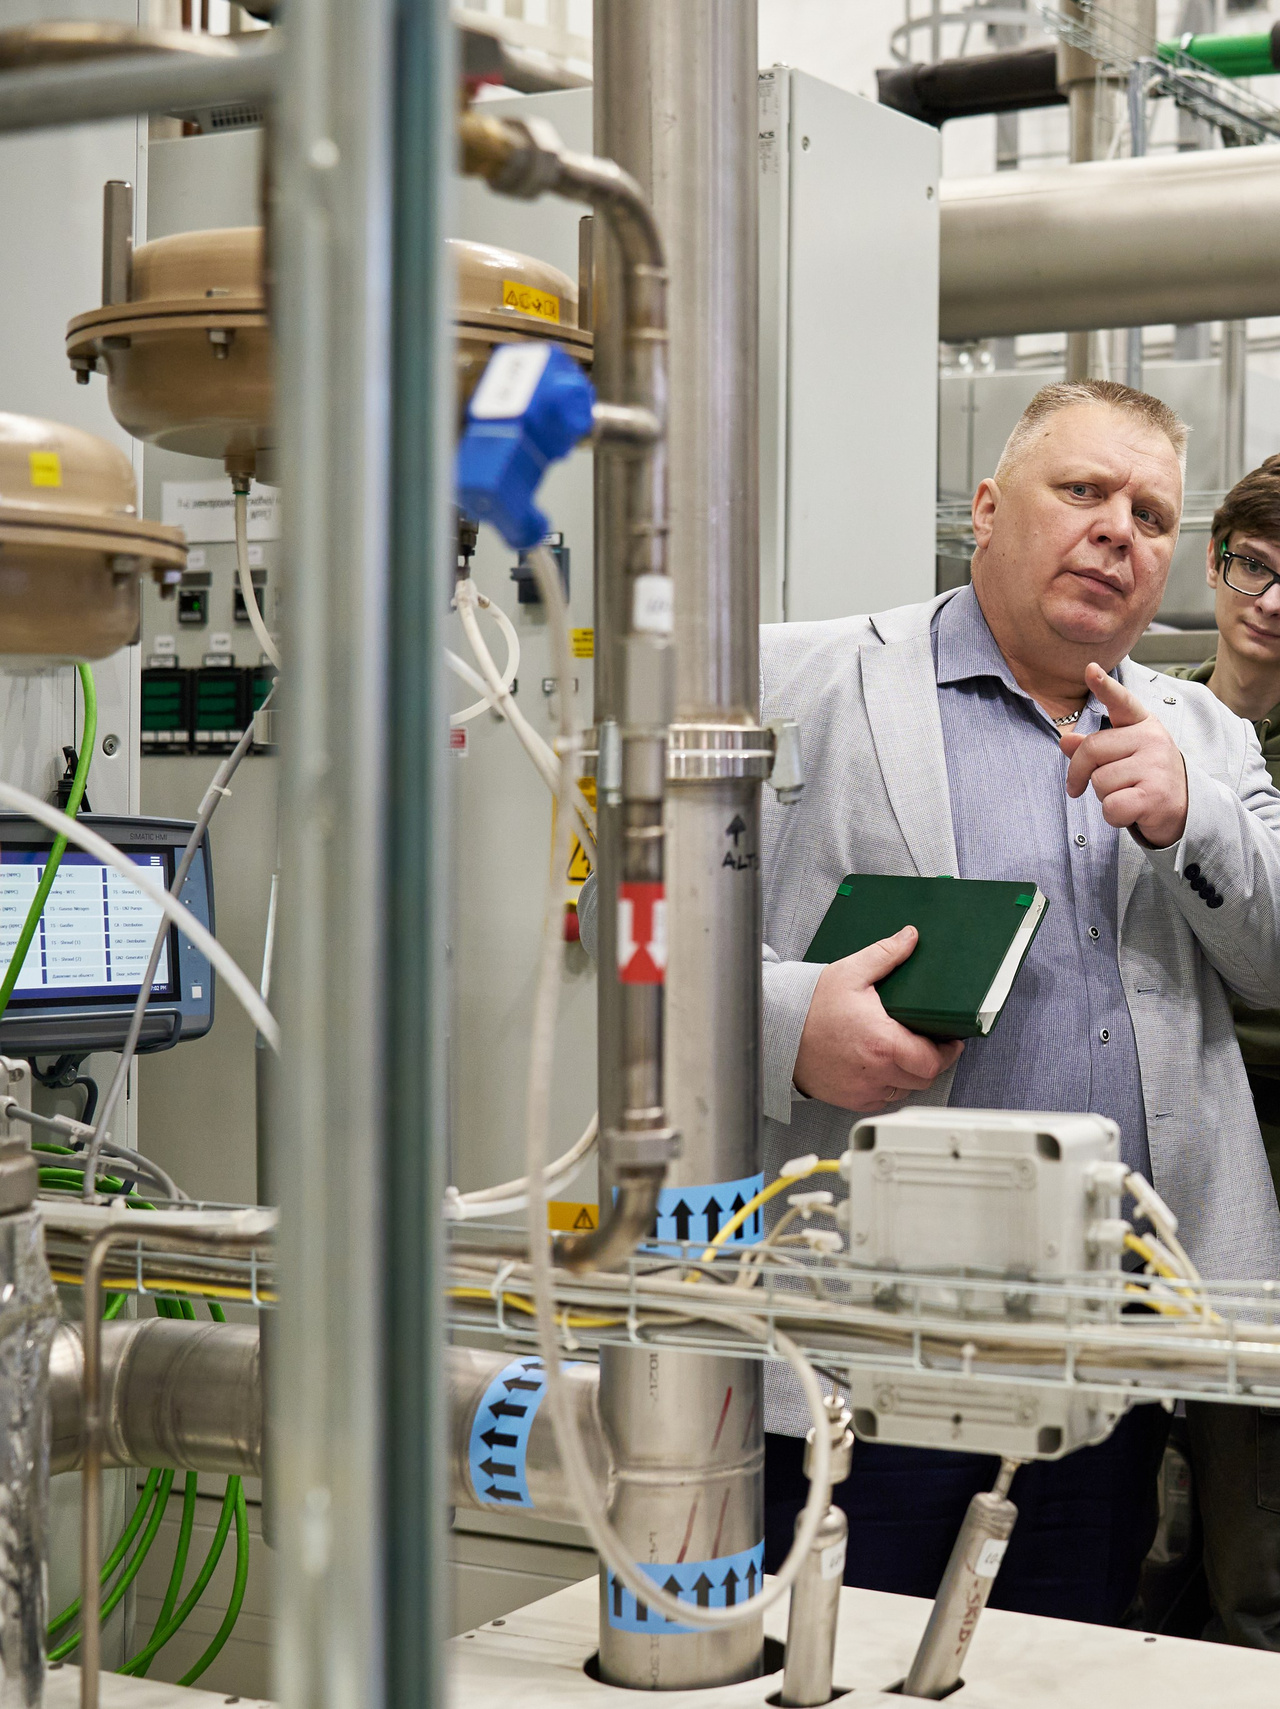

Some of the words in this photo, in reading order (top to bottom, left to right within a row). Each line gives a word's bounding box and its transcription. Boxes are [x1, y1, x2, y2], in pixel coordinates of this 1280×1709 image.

[758, 131, 775, 139] ACS
[129, 832, 154, 841] SIMATIC
[155, 833, 168, 841] HMI
